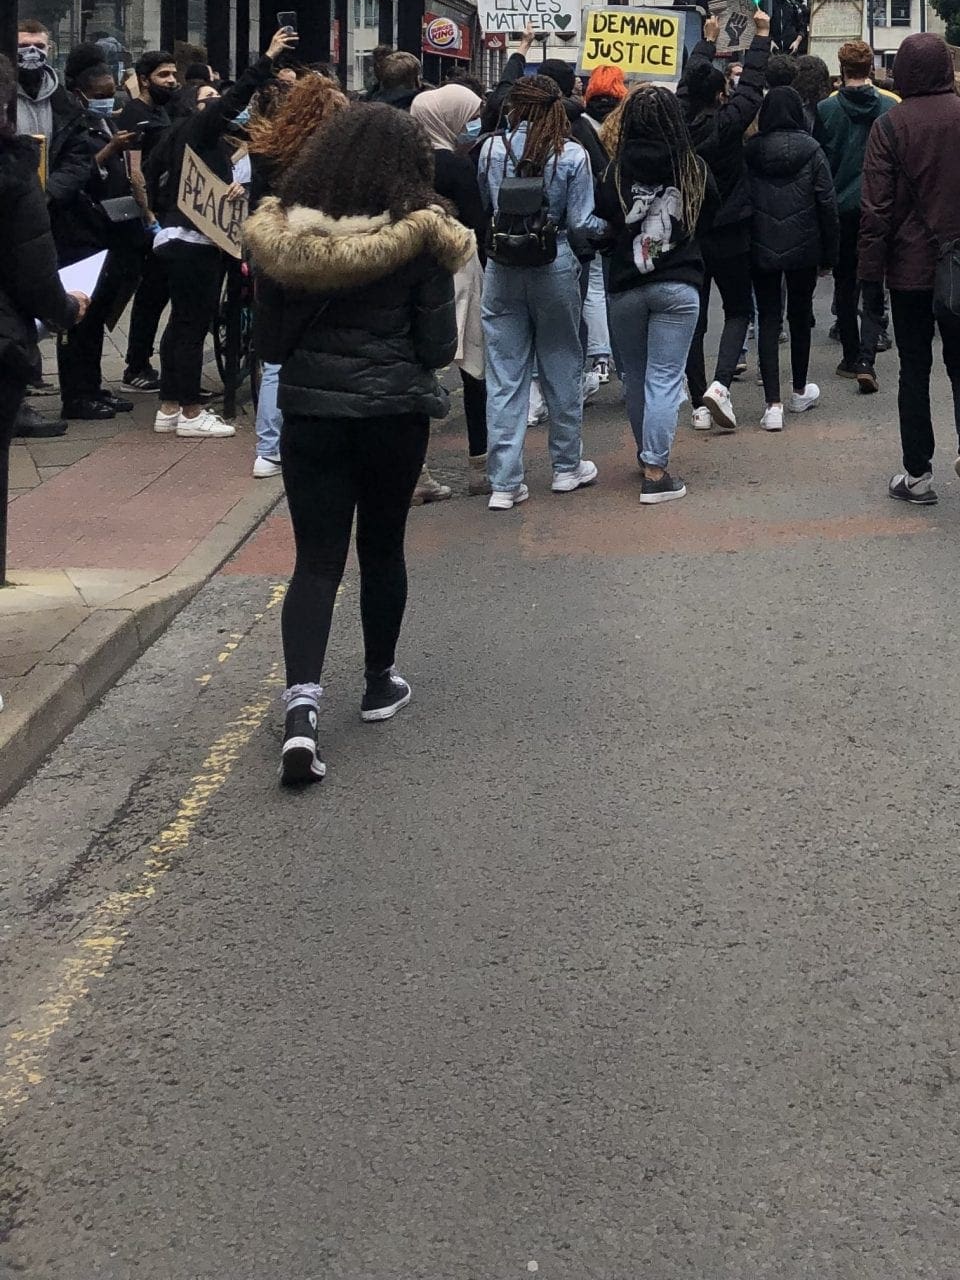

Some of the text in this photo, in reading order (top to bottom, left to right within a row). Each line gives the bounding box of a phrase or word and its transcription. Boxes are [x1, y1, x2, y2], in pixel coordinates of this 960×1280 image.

[486, 11, 556, 30] MATTER
[593, 13, 675, 37] DEMAND
[431, 29, 454, 40] KING
[587, 37, 674, 66] JUSTICE
